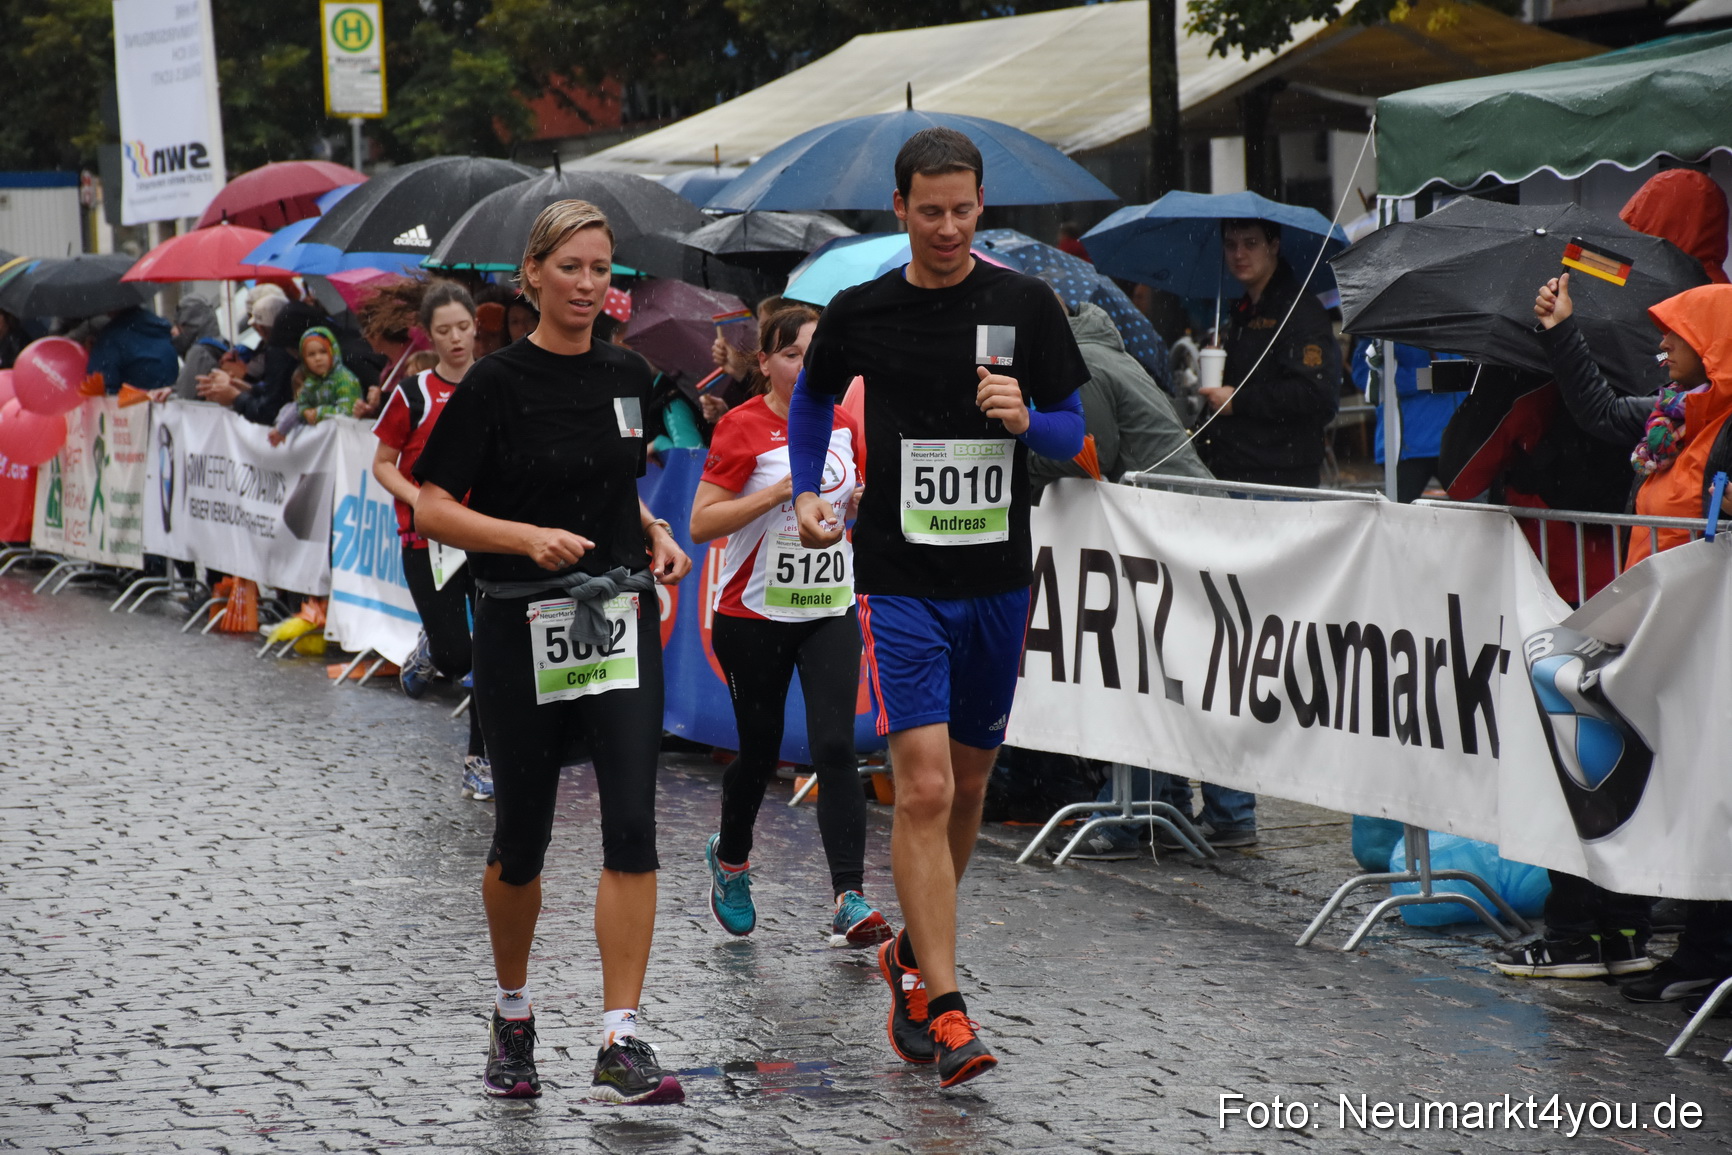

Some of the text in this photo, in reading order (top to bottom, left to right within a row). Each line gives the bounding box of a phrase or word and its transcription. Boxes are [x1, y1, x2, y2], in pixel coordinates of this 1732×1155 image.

[342, 19, 362, 42] H
[393, 237, 432, 247] adidas
[954, 443, 1005, 456] BOCK
[914, 465, 1003, 505] 5010
[930, 516, 987, 531] Andreas
[776, 551, 845, 584] 5120
[791, 593, 832, 606] Renate
